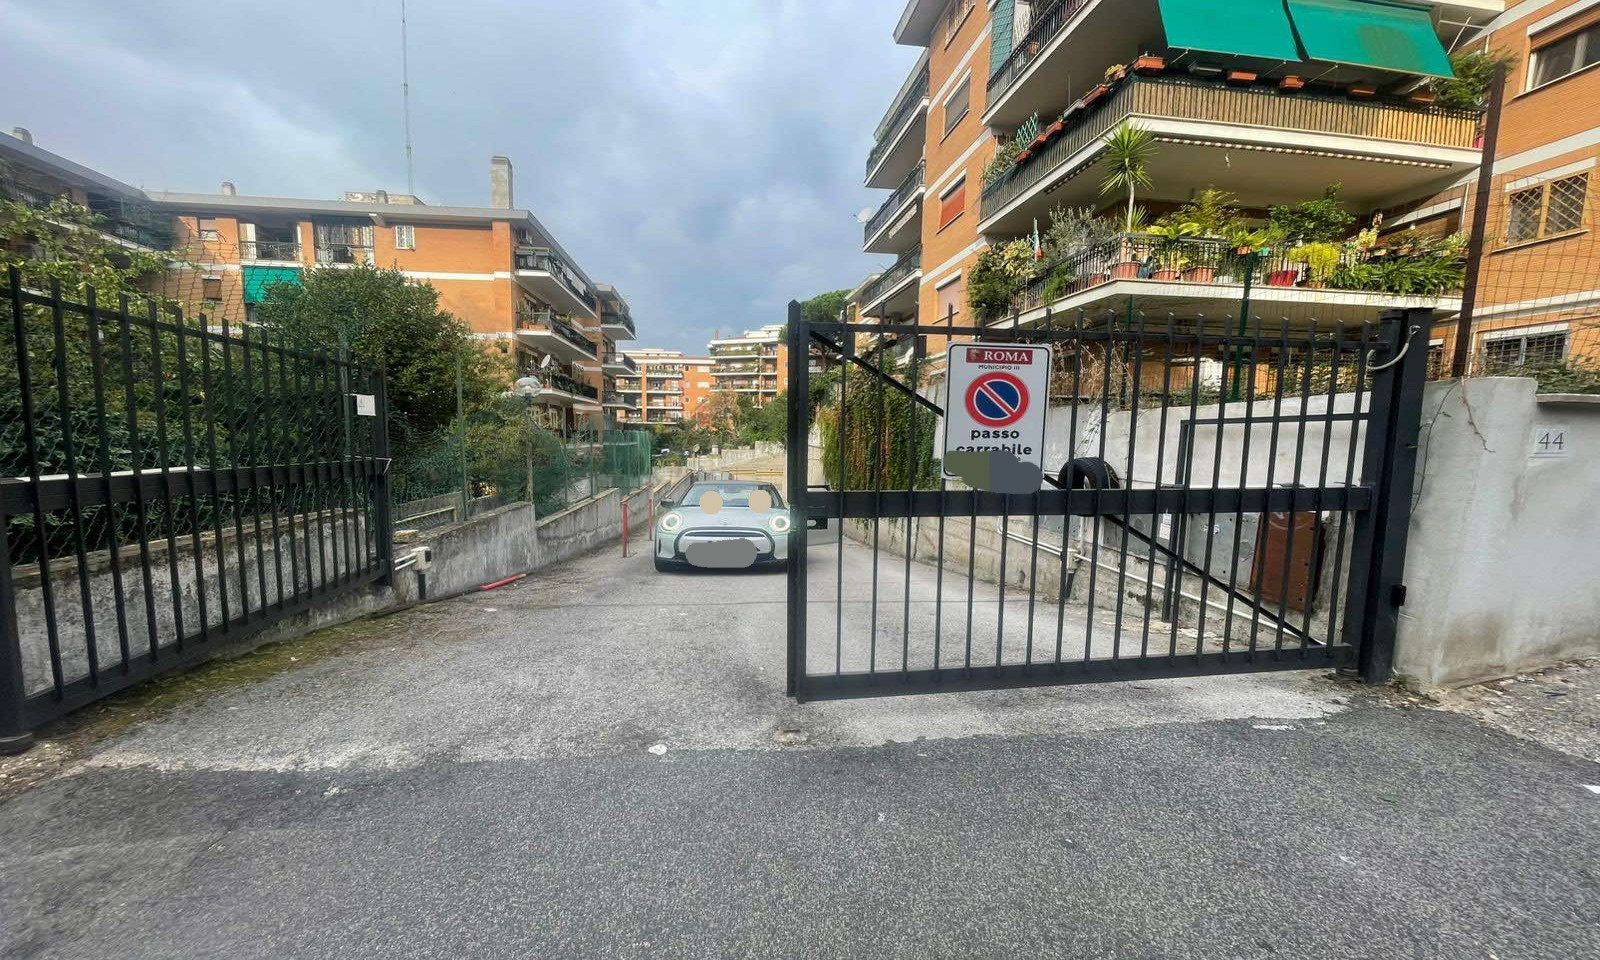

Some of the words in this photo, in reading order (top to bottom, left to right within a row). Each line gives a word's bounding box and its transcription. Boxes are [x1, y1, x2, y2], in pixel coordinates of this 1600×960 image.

[984, 350, 1029, 362] ROMA
[970, 429, 1020, 441] passo
[1538, 432, 1564, 450] 44
